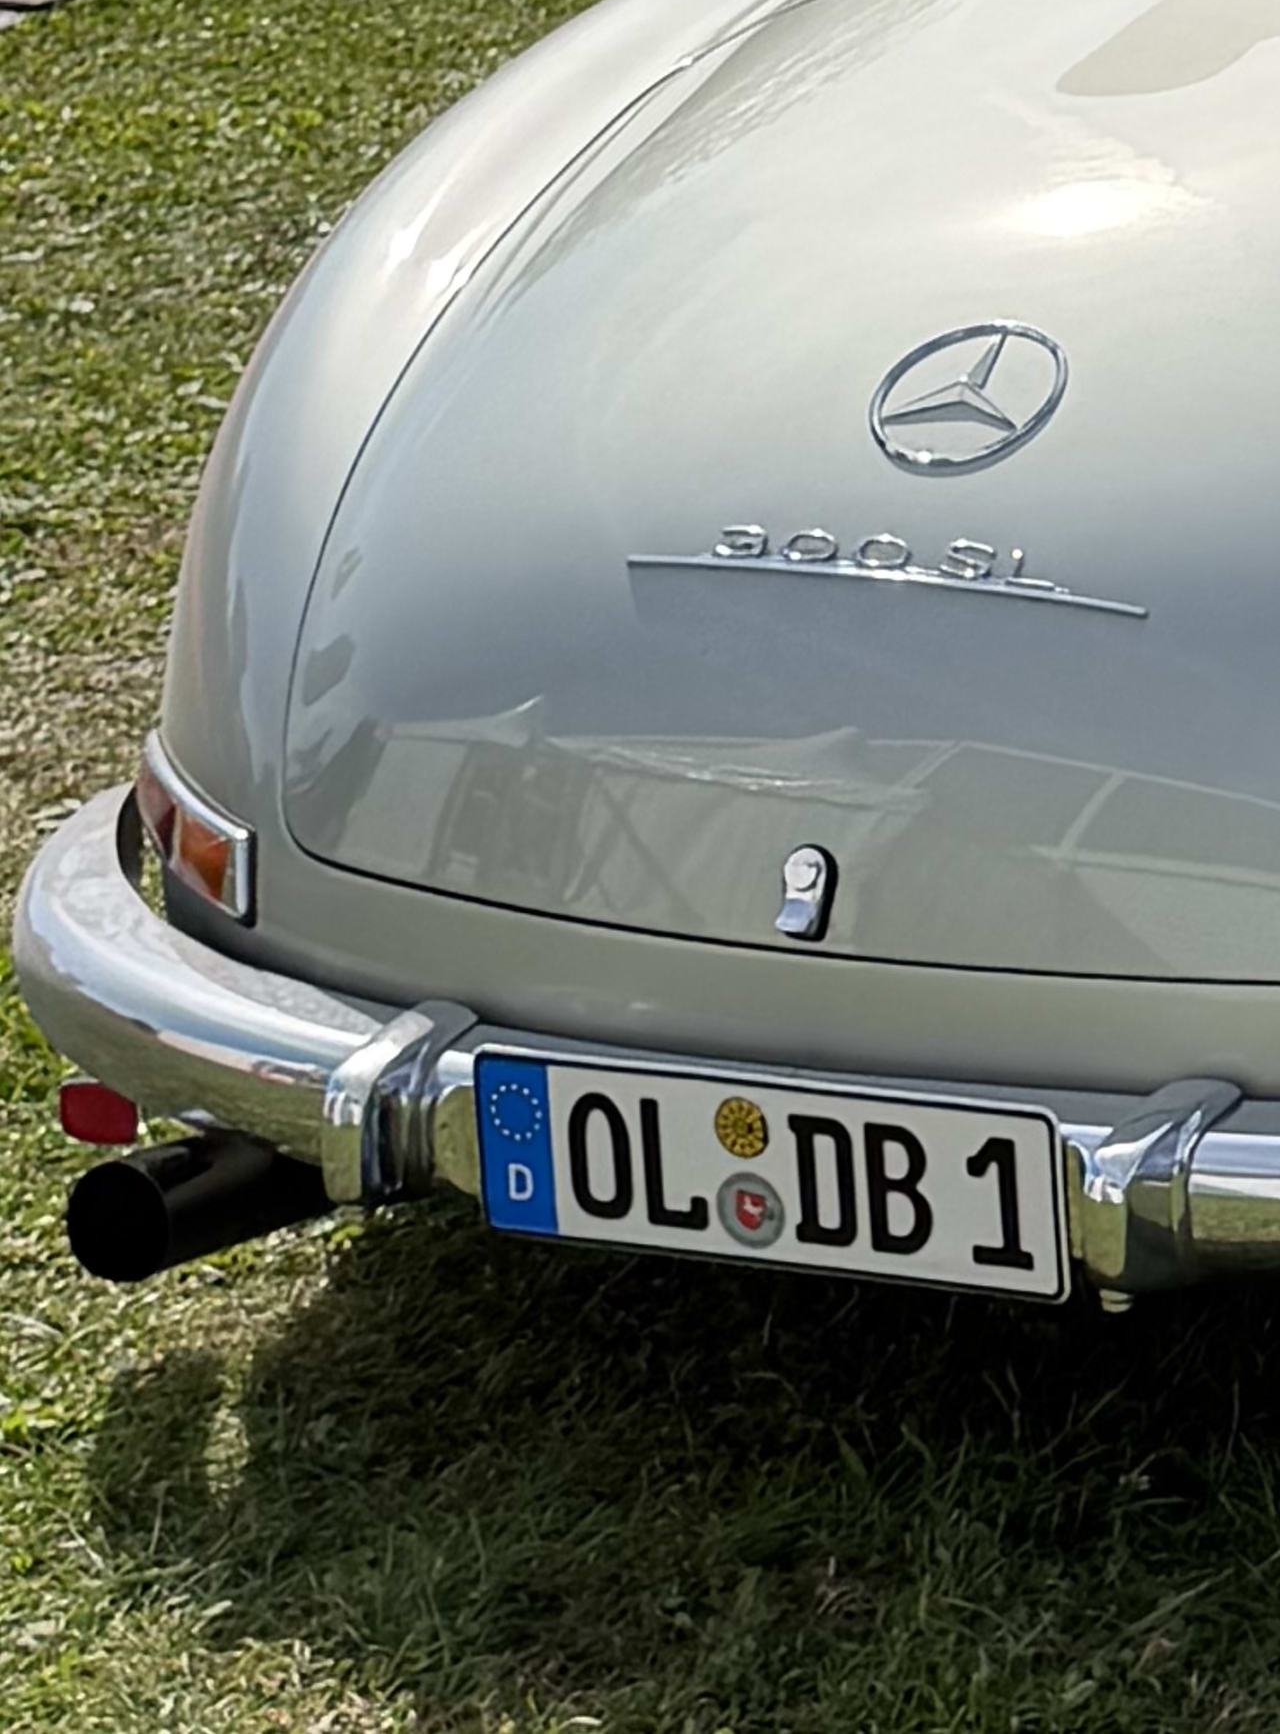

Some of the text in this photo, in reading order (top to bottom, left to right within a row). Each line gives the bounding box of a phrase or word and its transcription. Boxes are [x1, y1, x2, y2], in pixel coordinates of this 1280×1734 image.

[713, 524, 912, 570] 300
[508, 1163, 532, 1201] D
[568, 1092, 1034, 1271] OL DB 1
